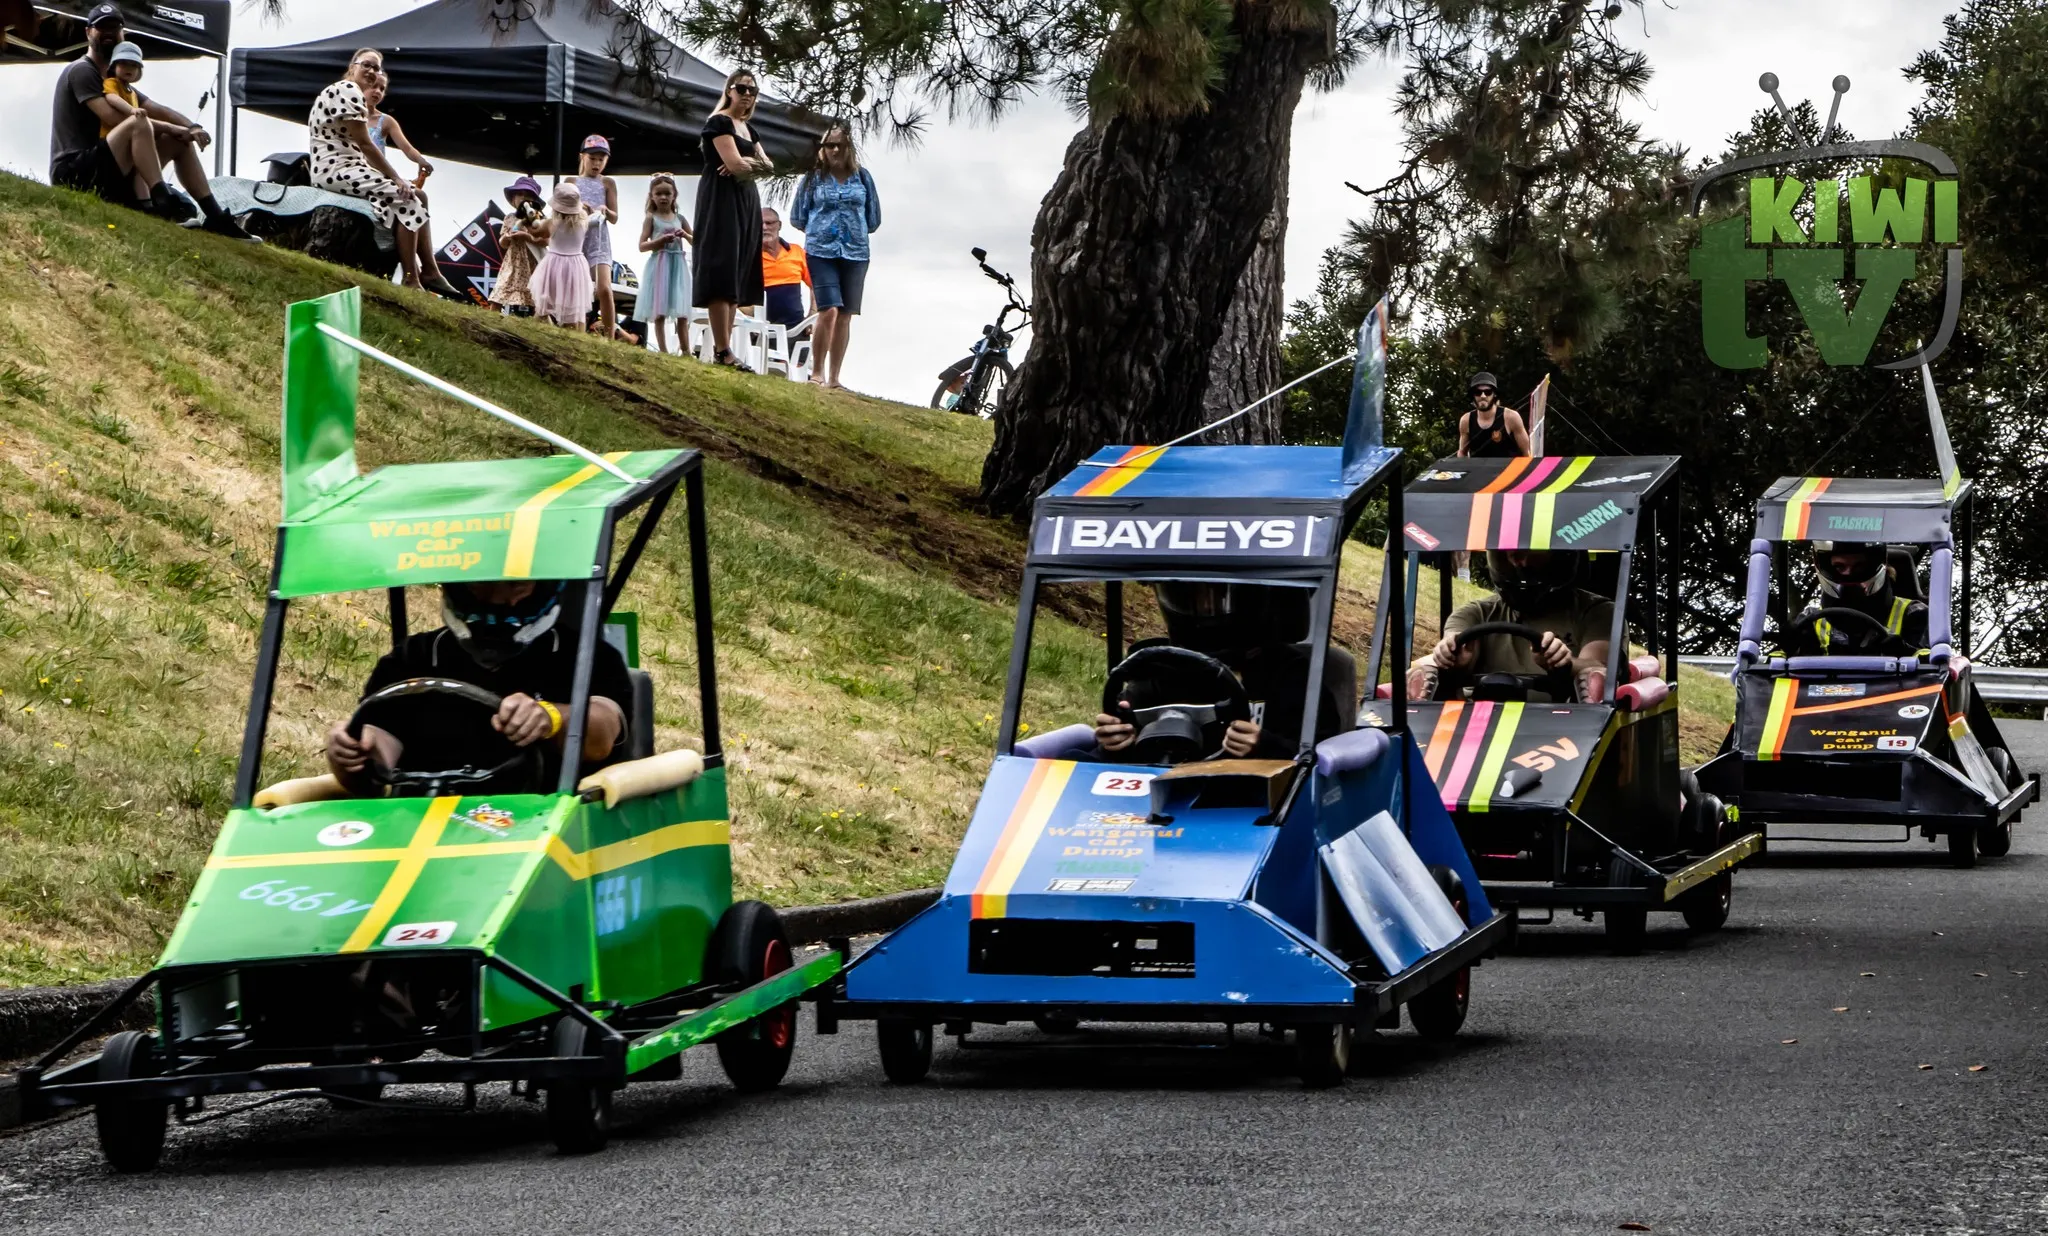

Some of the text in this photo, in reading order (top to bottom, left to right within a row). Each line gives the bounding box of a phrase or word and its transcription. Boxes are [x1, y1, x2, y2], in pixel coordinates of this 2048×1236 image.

[469, 229, 478, 238] 9
[449, 244, 461, 257] 36
[369, 512, 513, 538] Wanganui
[1555, 499, 1623, 544] TRASHPAK
[1828, 515, 1883, 531] TRASHPAK
[1070, 519, 1296, 549] BAYLEYS
[397, 551, 482, 571] Dump
[1809, 728, 1899, 737] Wanganui
[1887, 739, 1907, 748] 19
[1511, 737, 1580, 772] 5V
[1105, 778, 1143, 791] 23
[1048, 827, 1185, 839] Wanganui
[1062, 846, 1144, 859] Dump
[396, 928, 441, 942] 24
